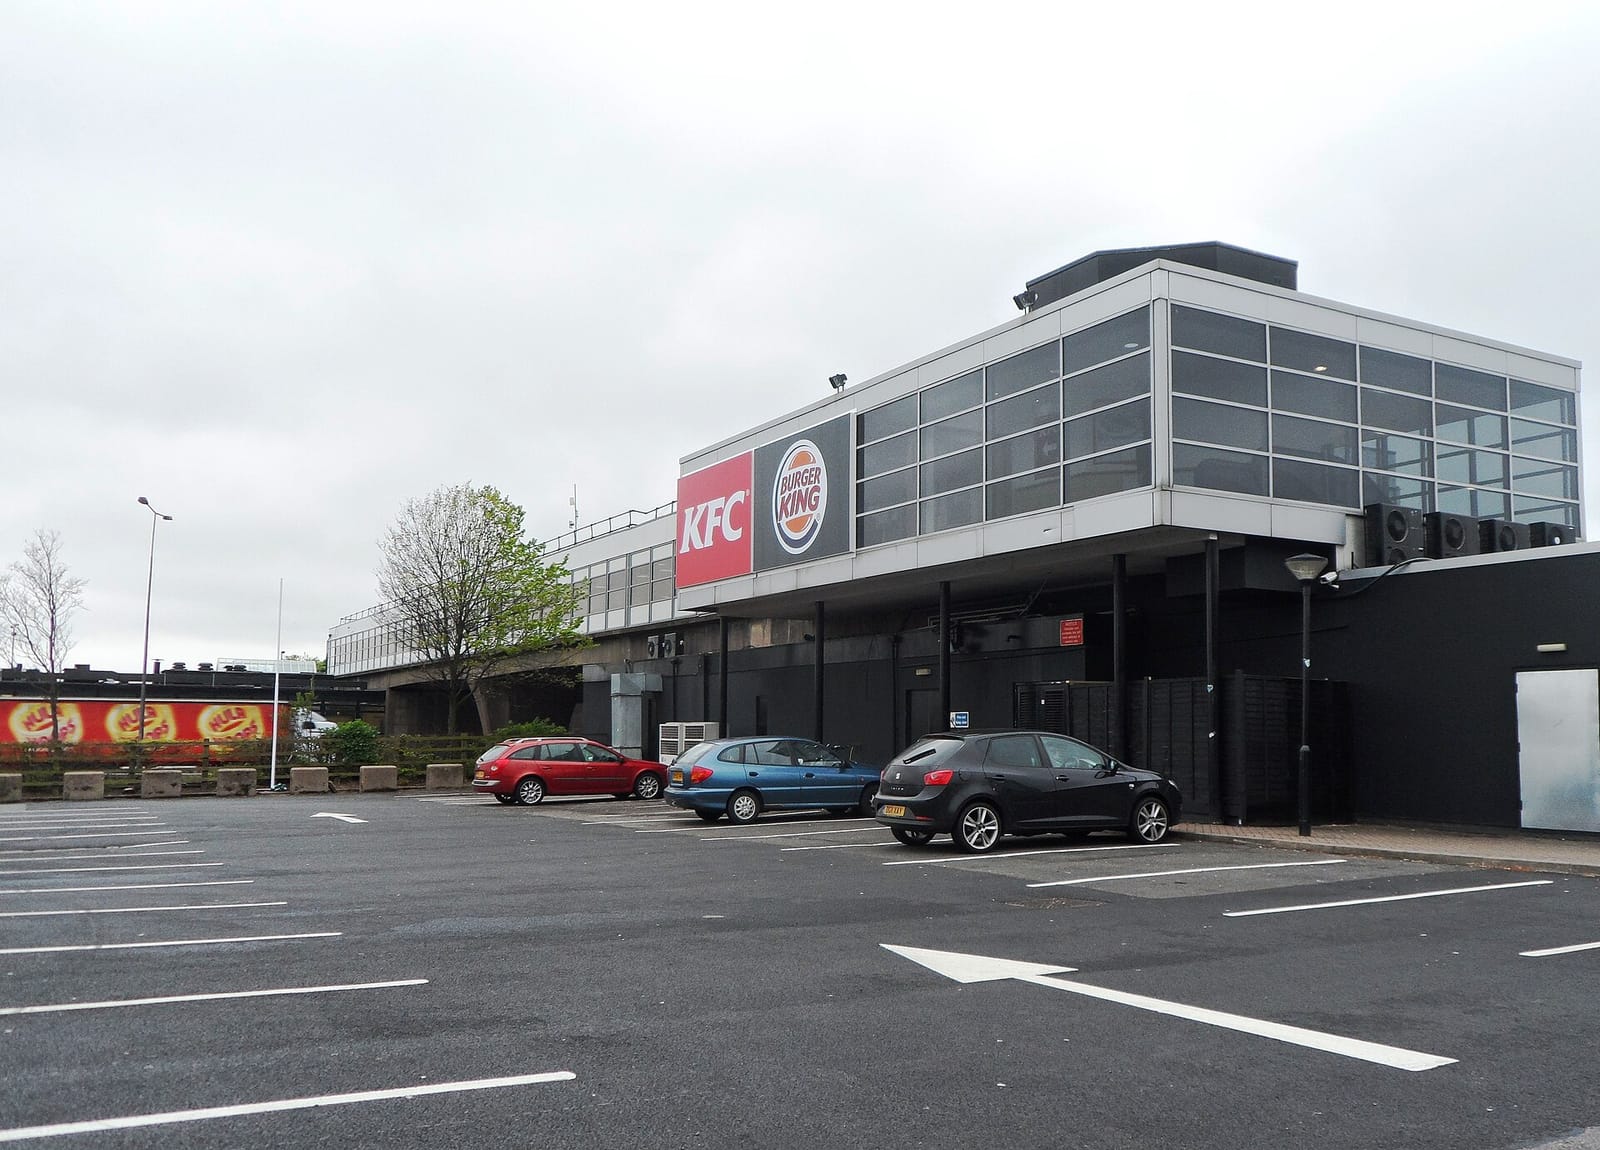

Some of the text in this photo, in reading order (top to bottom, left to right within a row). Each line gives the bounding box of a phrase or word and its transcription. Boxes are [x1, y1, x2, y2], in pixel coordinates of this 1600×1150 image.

[780, 466, 821, 495] BURGER
[779, 485, 821, 521] KING
[680, 489, 746, 554] KFC
